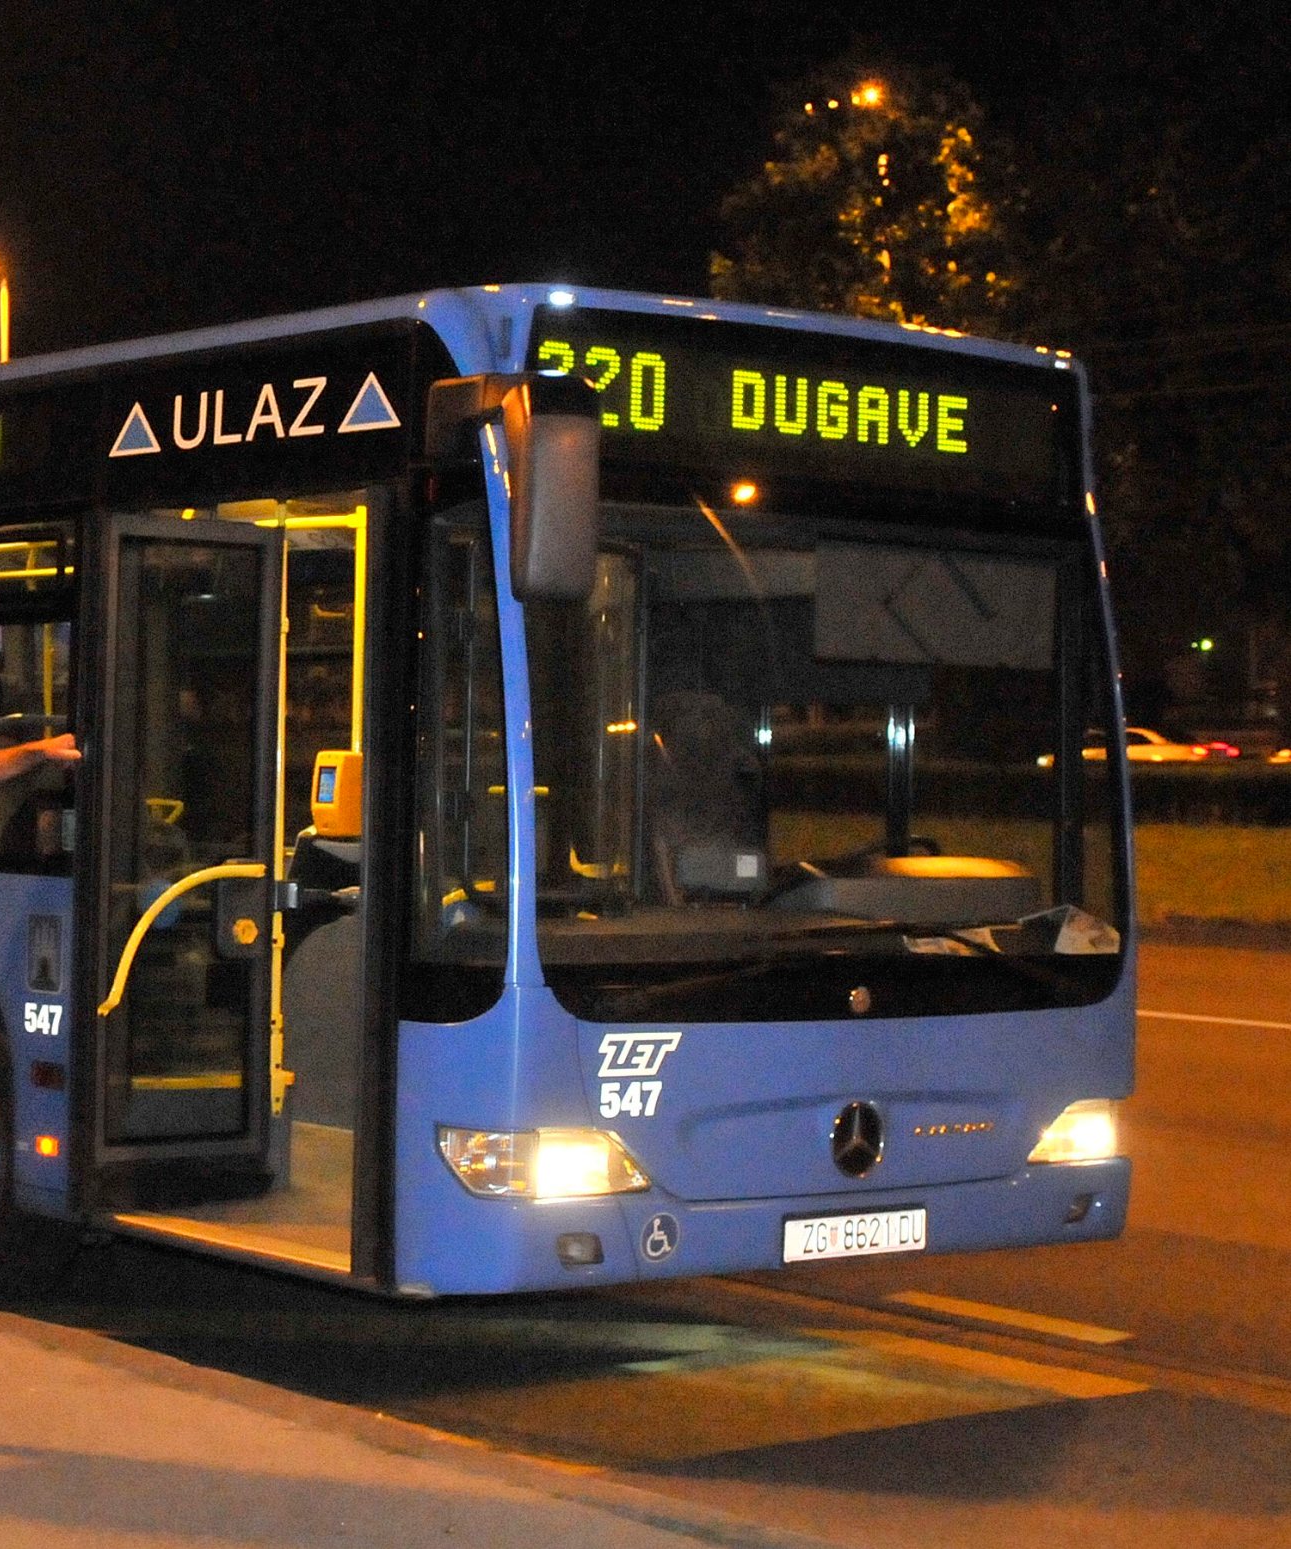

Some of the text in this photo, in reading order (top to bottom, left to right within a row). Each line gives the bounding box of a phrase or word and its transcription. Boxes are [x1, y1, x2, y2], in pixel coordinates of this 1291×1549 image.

[173, 377, 327, 450] ULAZ
[731, 369, 968, 454] DUGAVE
[24, 1002, 63, 1035] 547
[598, 1032, 682, 1077] ZET
[600, 1081, 662, 1118] 547
[803, 1213, 923, 1254] ZG 8621 DU
